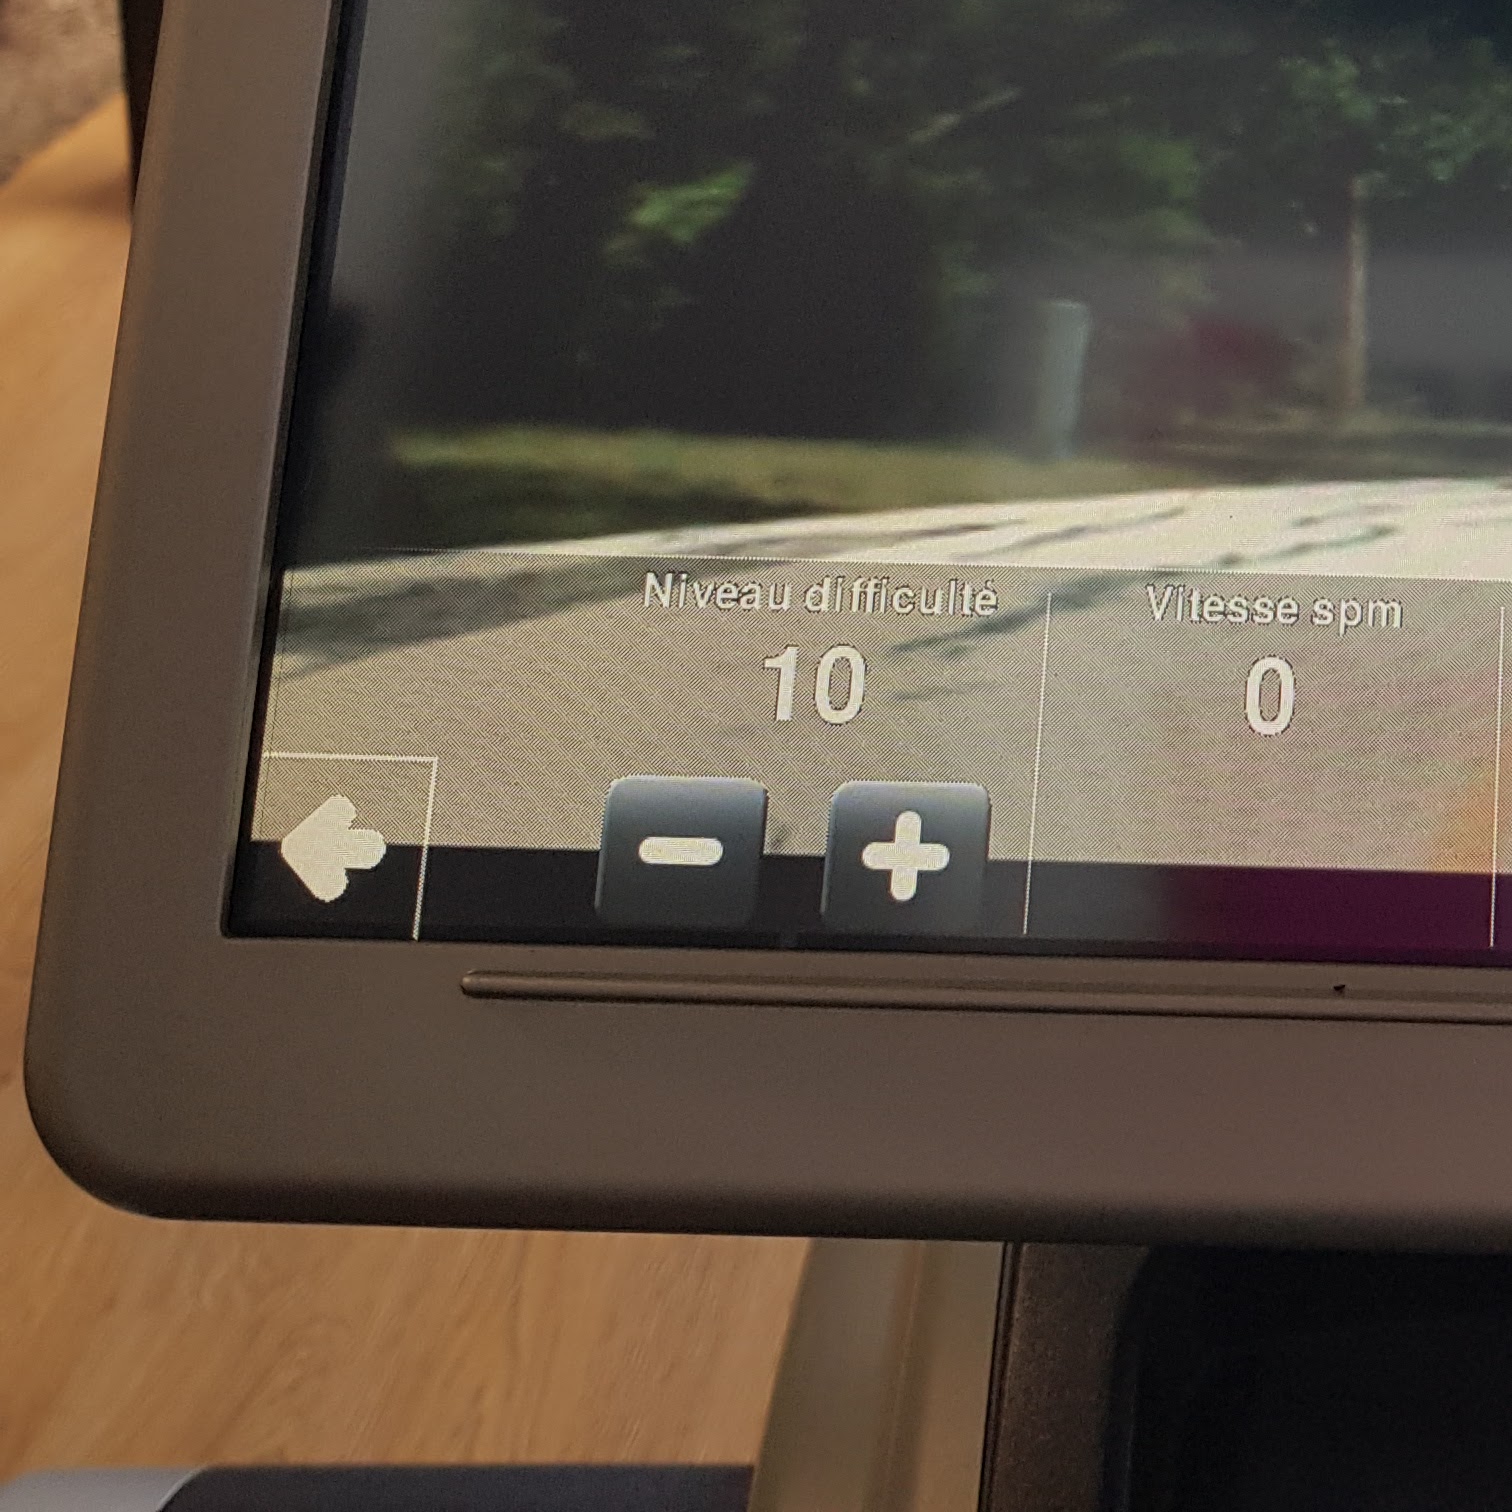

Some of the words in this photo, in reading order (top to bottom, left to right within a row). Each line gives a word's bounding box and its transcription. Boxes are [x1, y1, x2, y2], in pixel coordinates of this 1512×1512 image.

[643, 572, 792, 610] Niveau
[803, 574, 1000, 616] difficulté
[1146, 584, 1300, 625] Vitesse
[1311, 595, 1403, 636] spm
[763, 644, 867, 726] 10
[1245, 655, 1297, 736] 0
